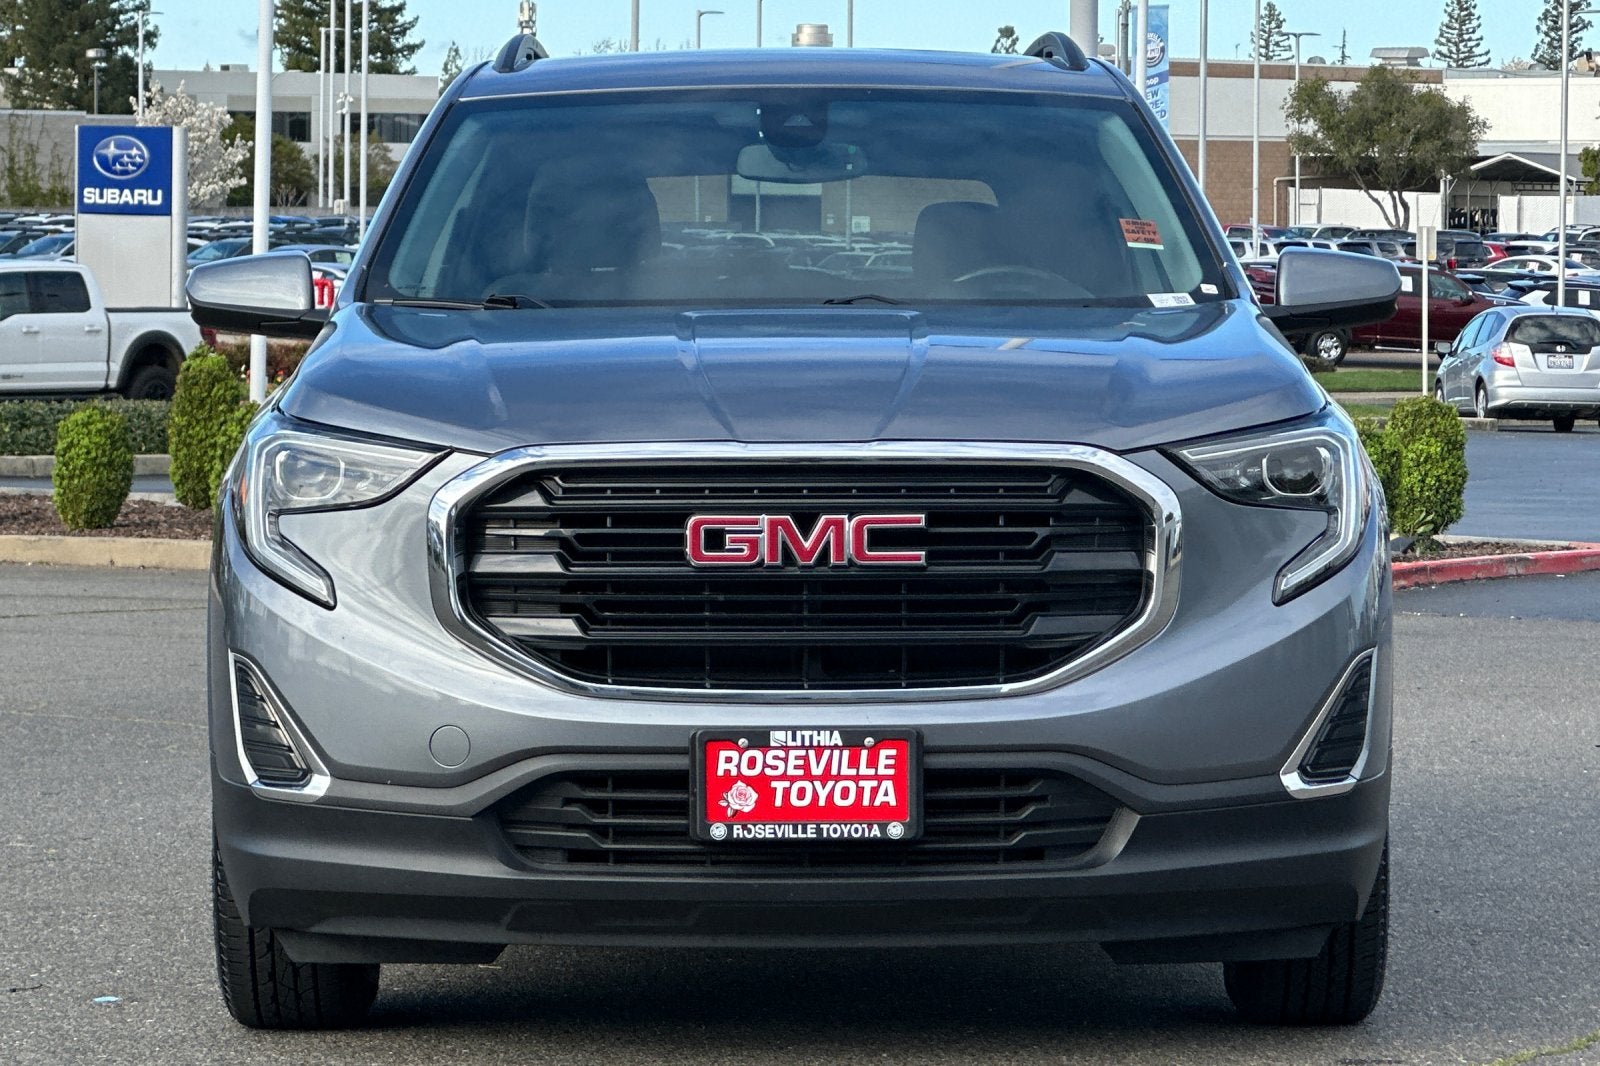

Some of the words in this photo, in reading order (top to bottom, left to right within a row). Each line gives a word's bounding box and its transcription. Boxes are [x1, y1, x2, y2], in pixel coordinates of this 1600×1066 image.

[1146, 88, 1160, 101] EW
[83, 187, 163, 205] SUBARU
[1125, 228, 1157, 236] SAFETY
[686, 513, 928, 567] GMC
[786, 730, 843, 747] LITHIA
[716, 748, 898, 777] ROSEVILLE
[770, 780, 898, 807] TOYOTA
[733, 823, 817, 839] ROSEVILLE
[820, 823, 881, 839] TOYOTA
